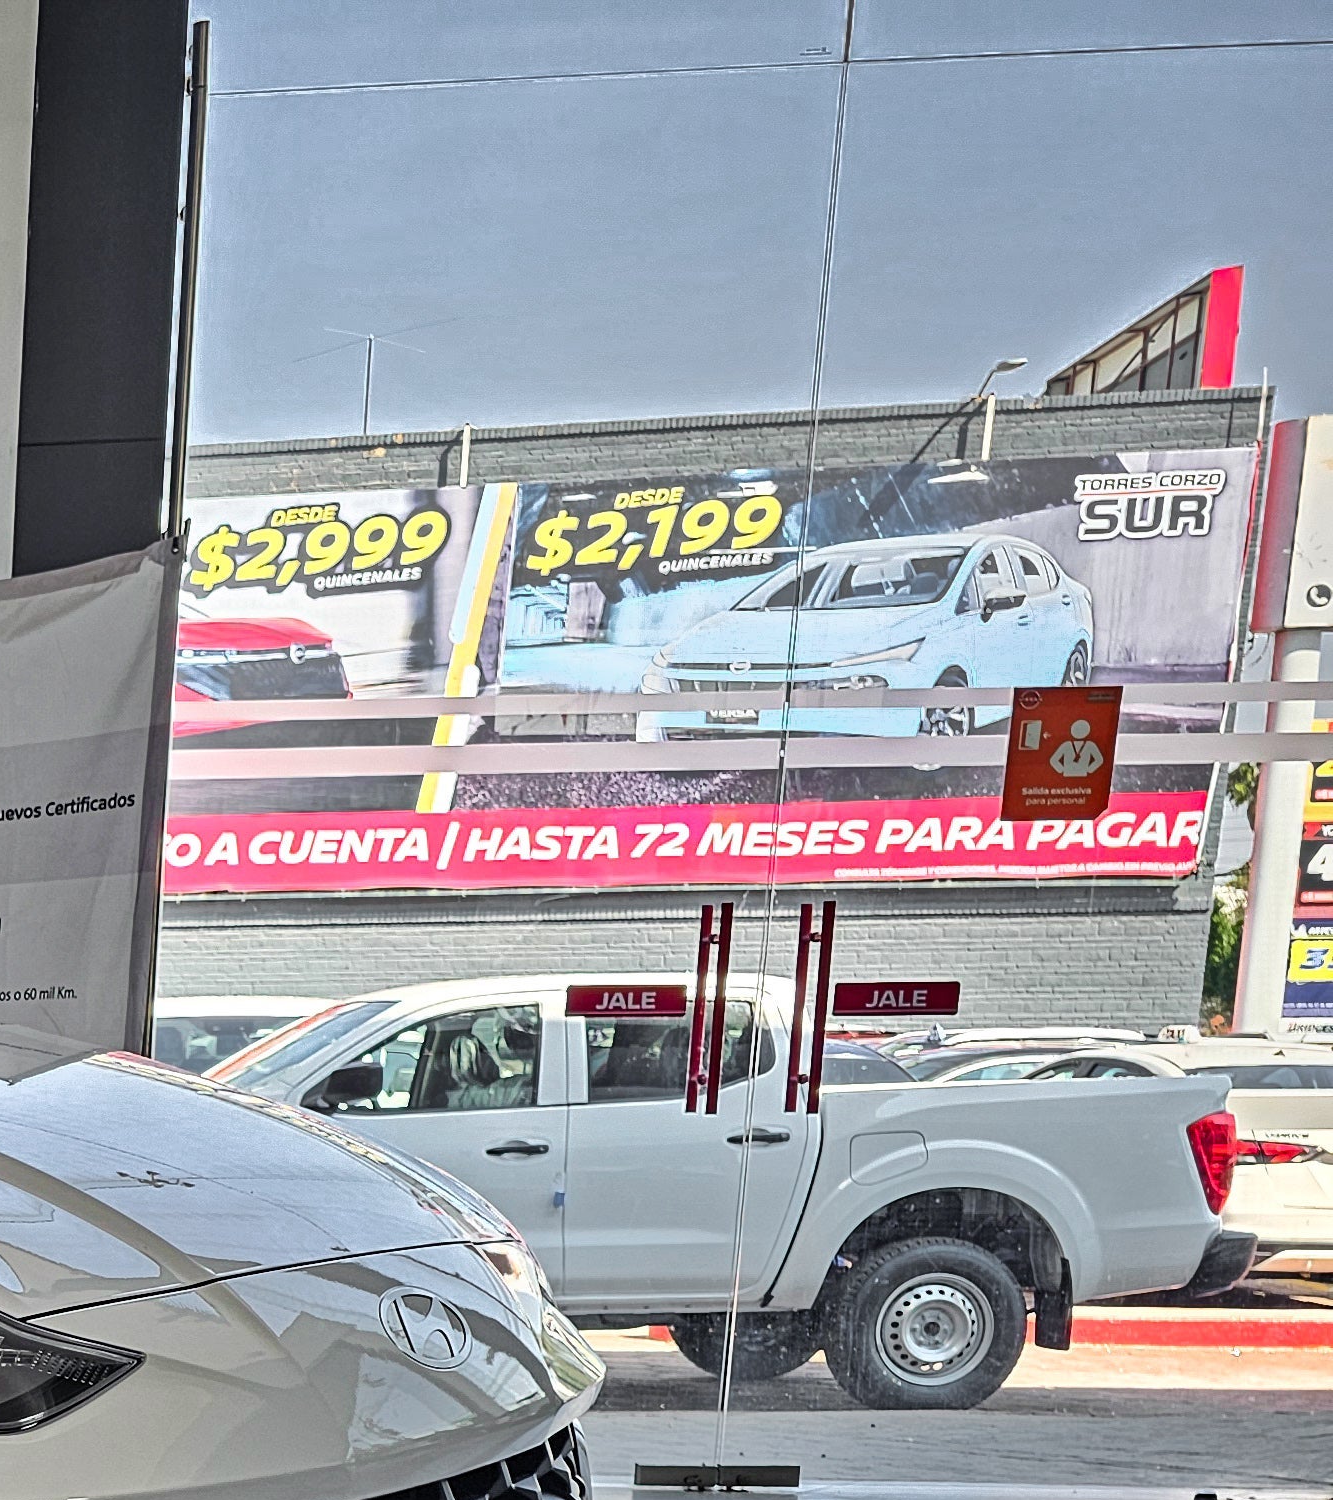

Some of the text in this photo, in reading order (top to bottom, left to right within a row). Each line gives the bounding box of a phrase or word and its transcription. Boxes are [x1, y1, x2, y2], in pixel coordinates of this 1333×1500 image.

[1079, 473, 1221, 491] TORRES CORZO
[614, 486, 685, 510] DESDE
[270, 504, 339, 527] DESDE
[1084, 495, 1208, 534] SUR
[526, 495, 783, 577] $2,199
[190, 511, 448, 591] $2,999
[658, 552, 774, 575] QUINCENALES
[313, 567, 423, 590] QUINCENALES
[1021, 787, 1092, 795] Salida exclusiva
[1025, 797, 1086, 806] para personal
[45, 792, 136, 817] Certificados
[165, 832, 202, 867] O
[204, 832, 239, 866] A
[248, 827, 430, 865] CUENTA
[463, 824, 620, 863] HASTA
[630, 822, 690, 858] 72
[696, 819, 870, 857] MESES
[874, 816, 1014, 854] PARA
[1026, 810, 1204, 851] PAGAR
[13, 991, 22, 1001] o
[24, 987, 37, 1000] 60
[39, 986, 56, 1000] mil
[57, 986, 78, 1000] Km.
[595, 991, 656, 1011] JALE
[866, 989, 928, 1008] JALE
